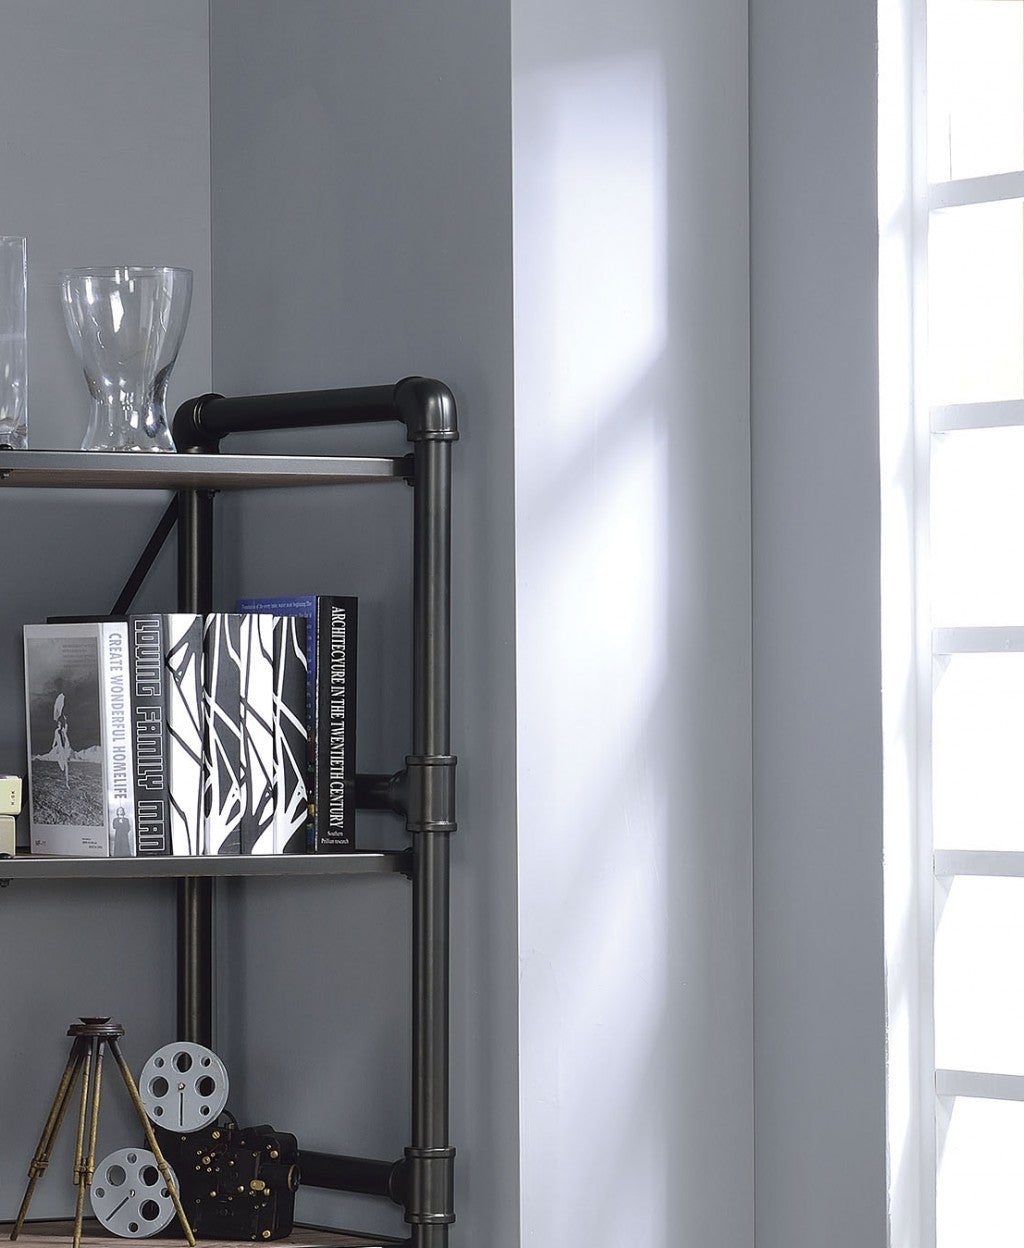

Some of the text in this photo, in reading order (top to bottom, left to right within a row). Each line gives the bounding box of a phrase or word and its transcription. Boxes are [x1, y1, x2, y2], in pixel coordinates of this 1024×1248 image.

[108, 632, 128, 800] CREATE WONDERFUL HOMELIFE
[331, 686, 345, 699] IN
[331, 701, 345, 719] THE
[331, 721, 345, 780] TWENTIETH
[330, 781, 345, 829] CENTURY
